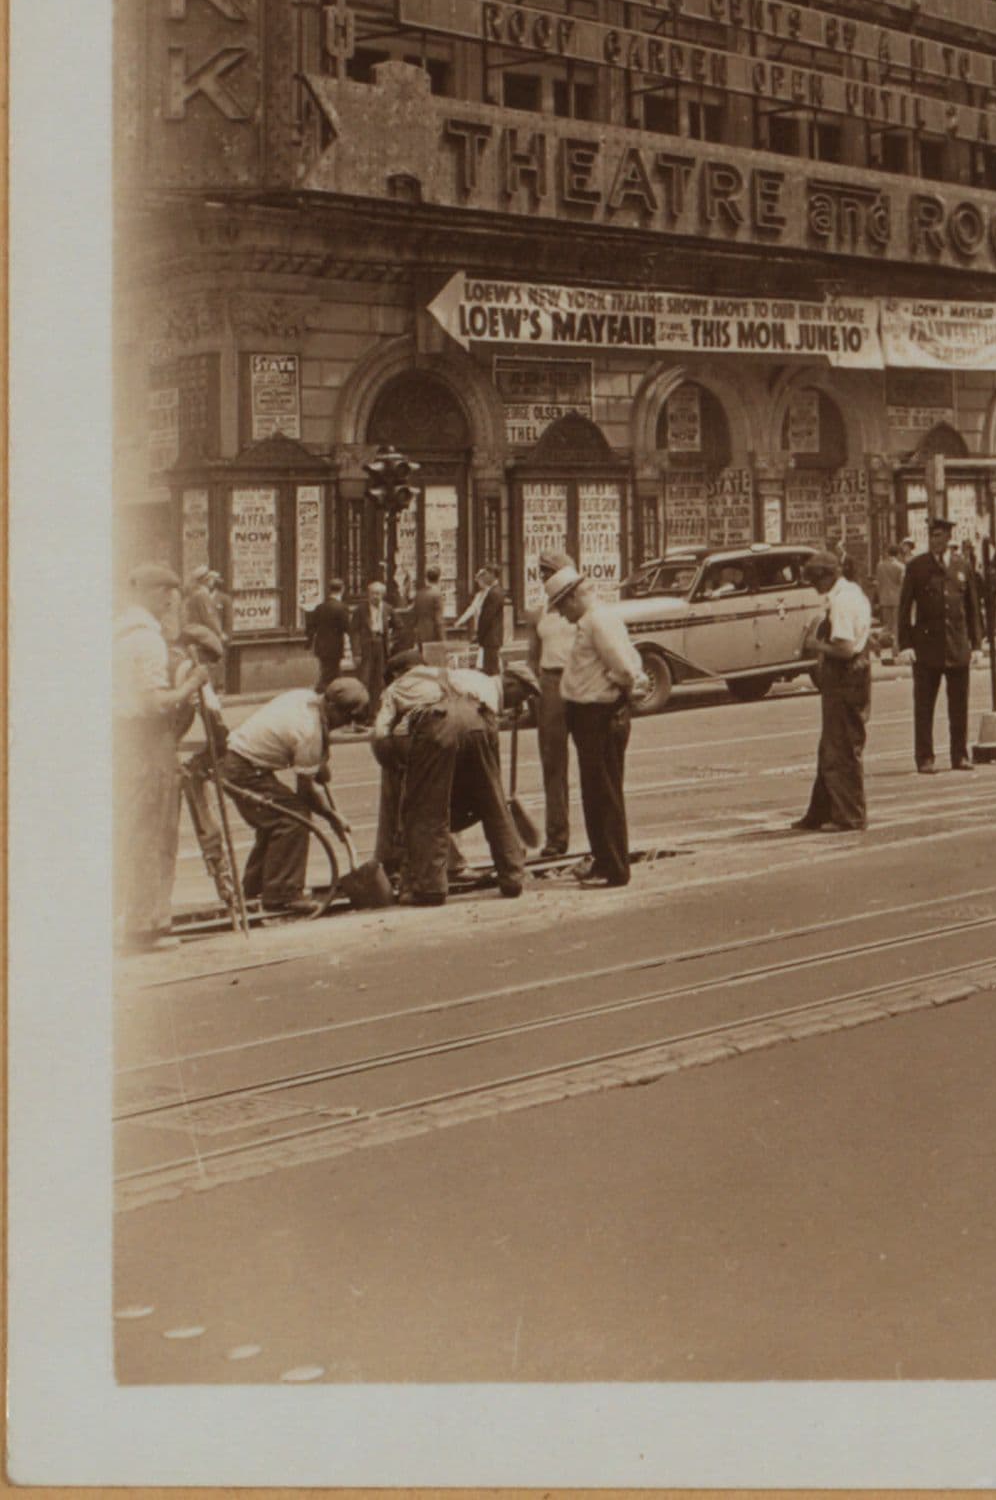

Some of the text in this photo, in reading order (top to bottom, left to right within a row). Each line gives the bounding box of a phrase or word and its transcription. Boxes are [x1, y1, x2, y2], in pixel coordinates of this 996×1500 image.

[483, 1, 576, 54] ROOF
[603, 29, 729, 87] GARDEN
[752, 61, 824, 109] OPEN
[845, 81, 927, 131] UNTIL
[443, 118, 789, 231] THEATRE
[808, 180, 893, 248] and
[463, 283, 865, 324] LOEW'S NEW YORK THEATRE SHOWS MOVE TO OUR NEW HOME
[459, 304, 542, 340] LOEW'S
[551, 311, 656, 345] MAYFAIR
[690, 318, 731, 348] THIS
[737, 322, 793, 350] MON.
[797, 324, 838, 352] JUNE
[254, 361, 296, 372] STATE
[235, 531, 272, 542] NOW
[582, 564, 617, 578] NOW
[233, 606, 272, 618] NOW
